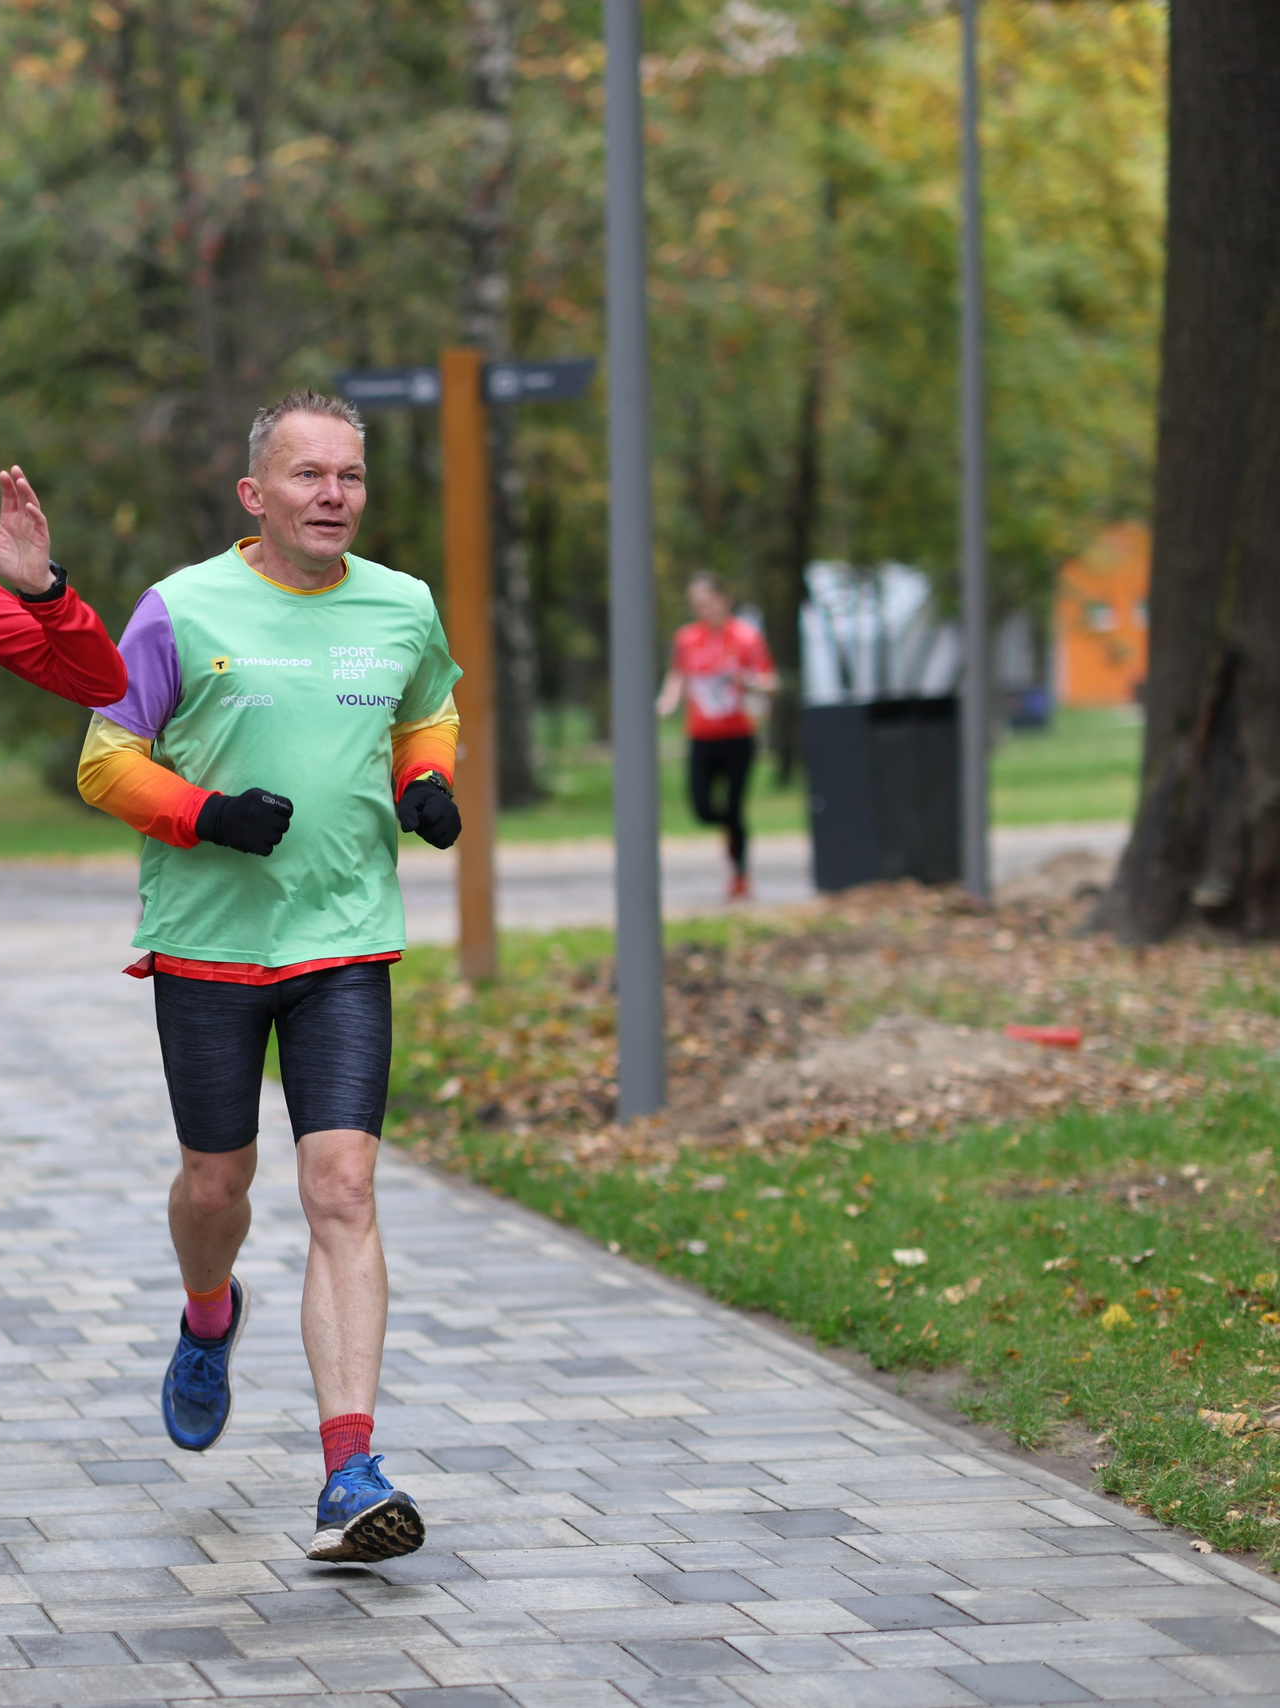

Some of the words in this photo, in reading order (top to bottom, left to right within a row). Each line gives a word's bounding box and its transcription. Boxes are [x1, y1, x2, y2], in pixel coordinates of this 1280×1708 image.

[329, 646, 375, 657] SPORT
[234, 657, 312, 667] ТИНЬКОФФ
[341, 658, 403, 672] MARAFON
[332, 668, 367, 679] FEST
[336, 694, 401, 709] VOLUNTEE
